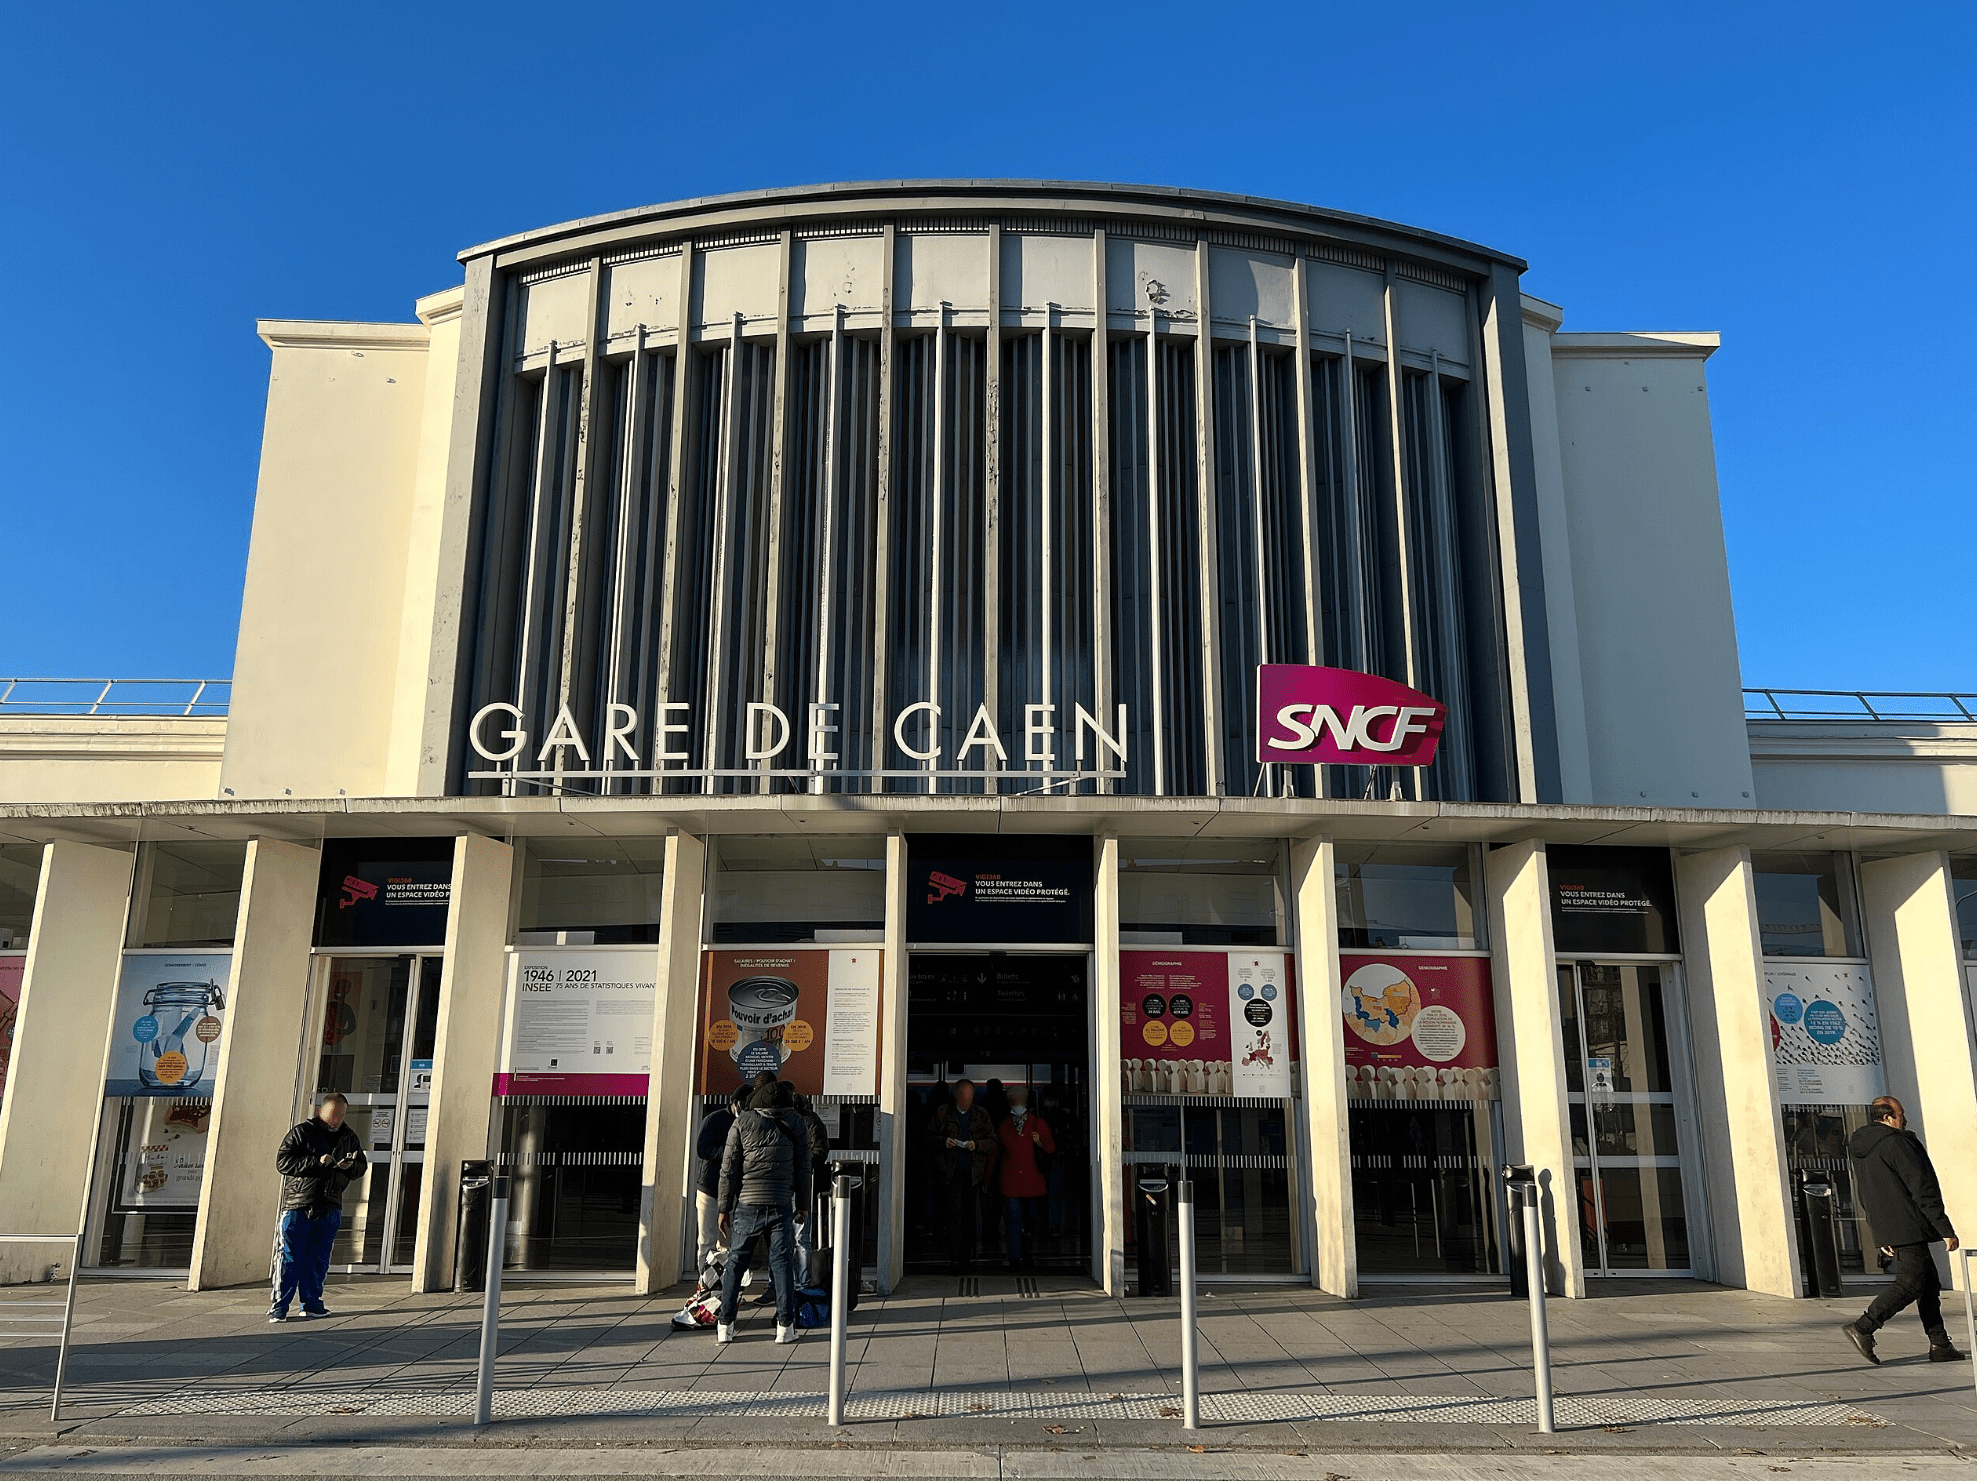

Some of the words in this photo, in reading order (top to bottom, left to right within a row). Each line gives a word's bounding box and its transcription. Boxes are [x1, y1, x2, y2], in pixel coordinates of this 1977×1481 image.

[469, 702, 690, 762] GARE
[746, 702, 839, 761] DE
[893, 701, 1127, 762] CAEN
[1267, 704, 1436, 752] SNCF
[423, 890, 444, 898] VIDÉO
[523, 970, 554, 982] 1946
[566, 970, 597, 982] 2021
[522, 983, 552, 992] INSEE
[731, 1004, 761, 1024] Pouvoir
[763, 1005, 794, 1024] d'achat
